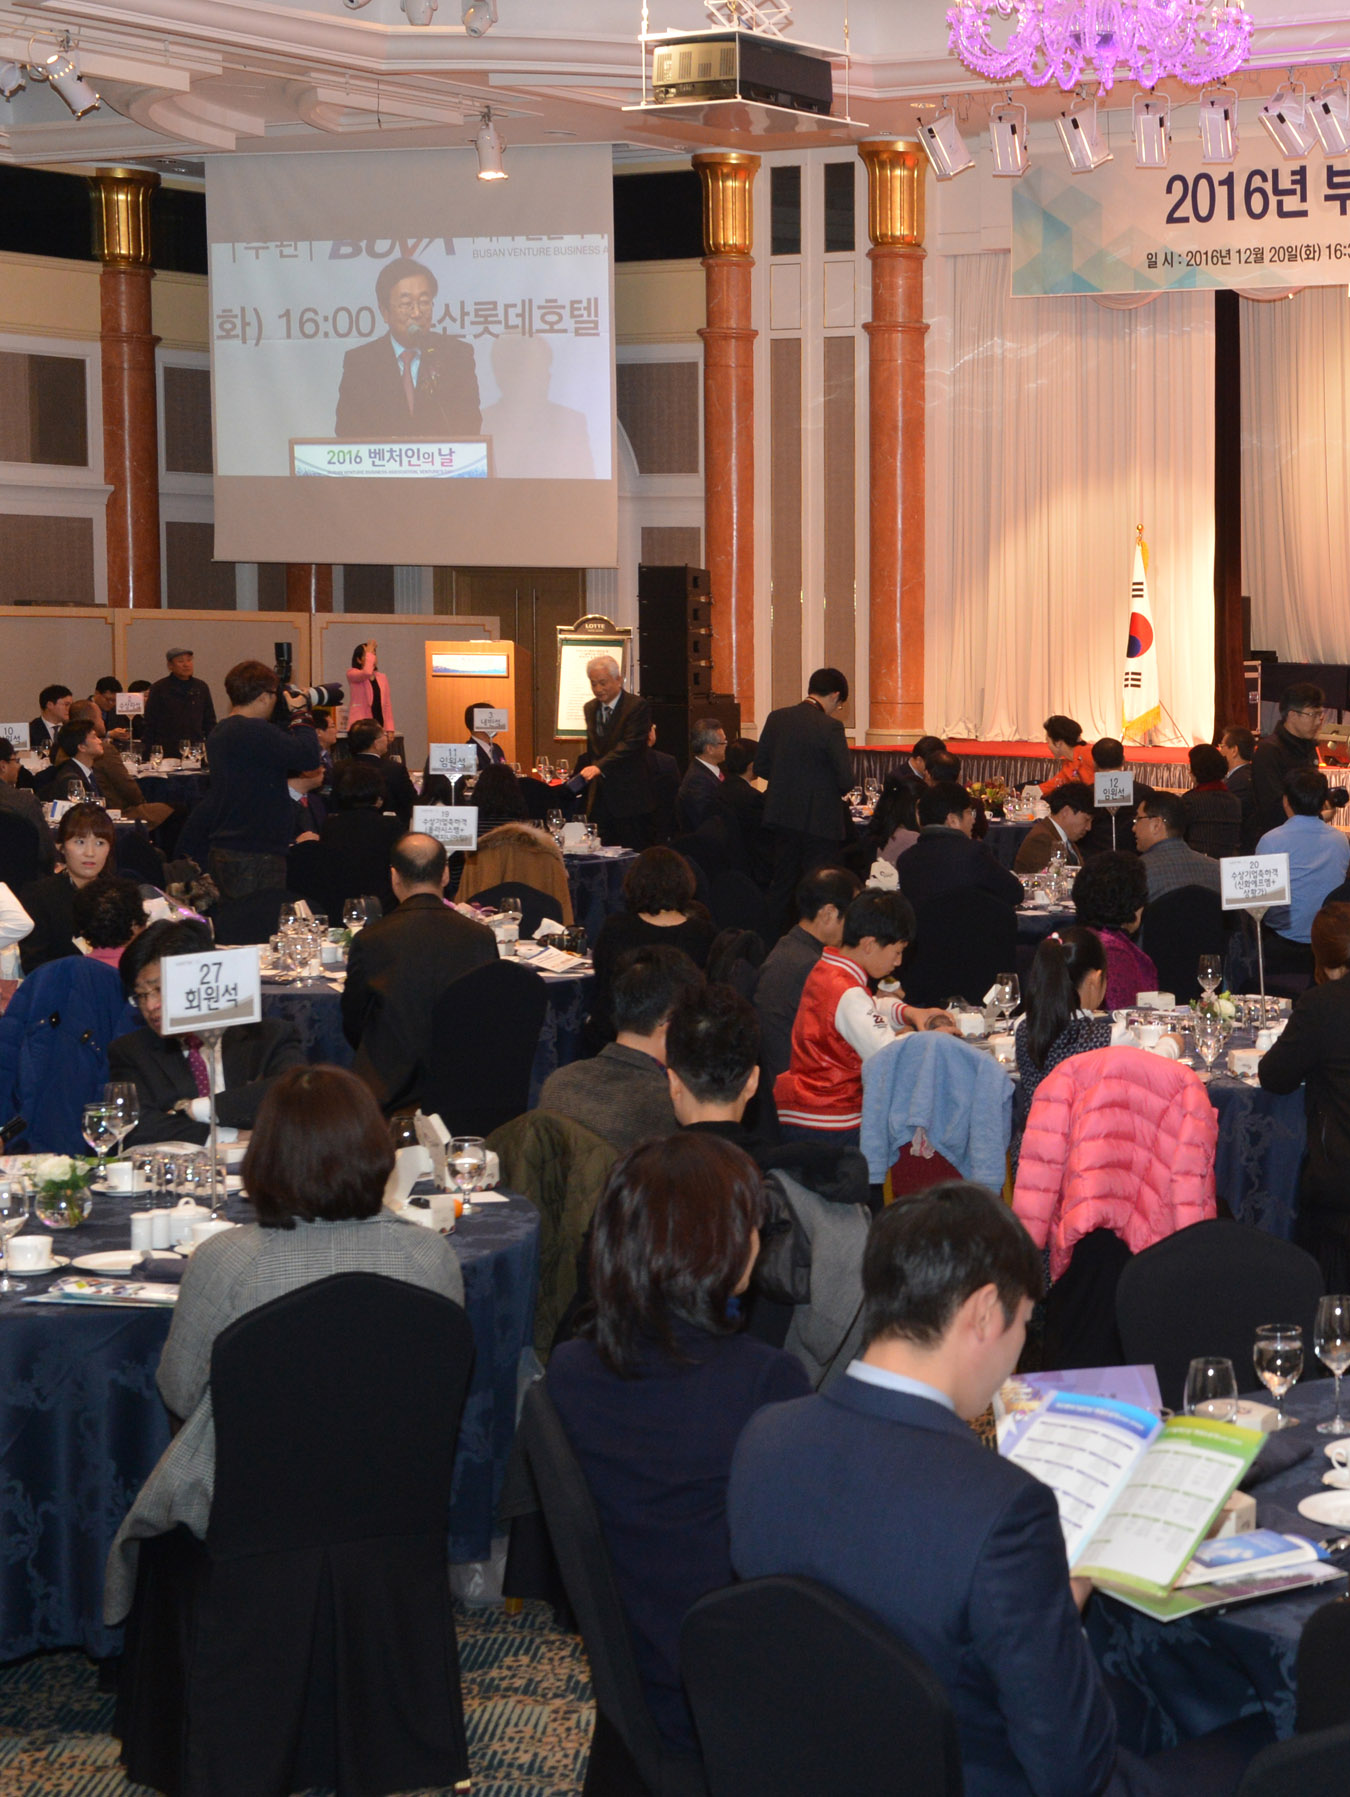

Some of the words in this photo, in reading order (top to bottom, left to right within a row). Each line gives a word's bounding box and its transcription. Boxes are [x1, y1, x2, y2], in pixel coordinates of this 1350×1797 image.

[1166, 164, 1309, 225] 2016년
[472, 247, 506, 259] BUSAN
[507, 246, 553, 257] VENTURE
[553, 245, 602, 256] BUSINESS
[1146, 251, 1159, 269] 일
[1185, 247, 1233, 267] 2016년
[1237, 246, 1266, 265] 12월
[1268, 243, 1322, 264] 20일(화)
[278, 305, 377, 340] 16:00
[430, 297, 601, 340] 산롯데호텔
[327, 449, 363, 466] 2016
[368, 448, 435, 468] 벤처인의
[437, 447, 456, 468] 날
[4, 726, 14, 736] 10
[1110, 777, 1119, 788] 12
[1249, 861, 1260, 869] 20
[200, 962, 222, 985] 27
[184, 982, 239, 1011] 회원석
